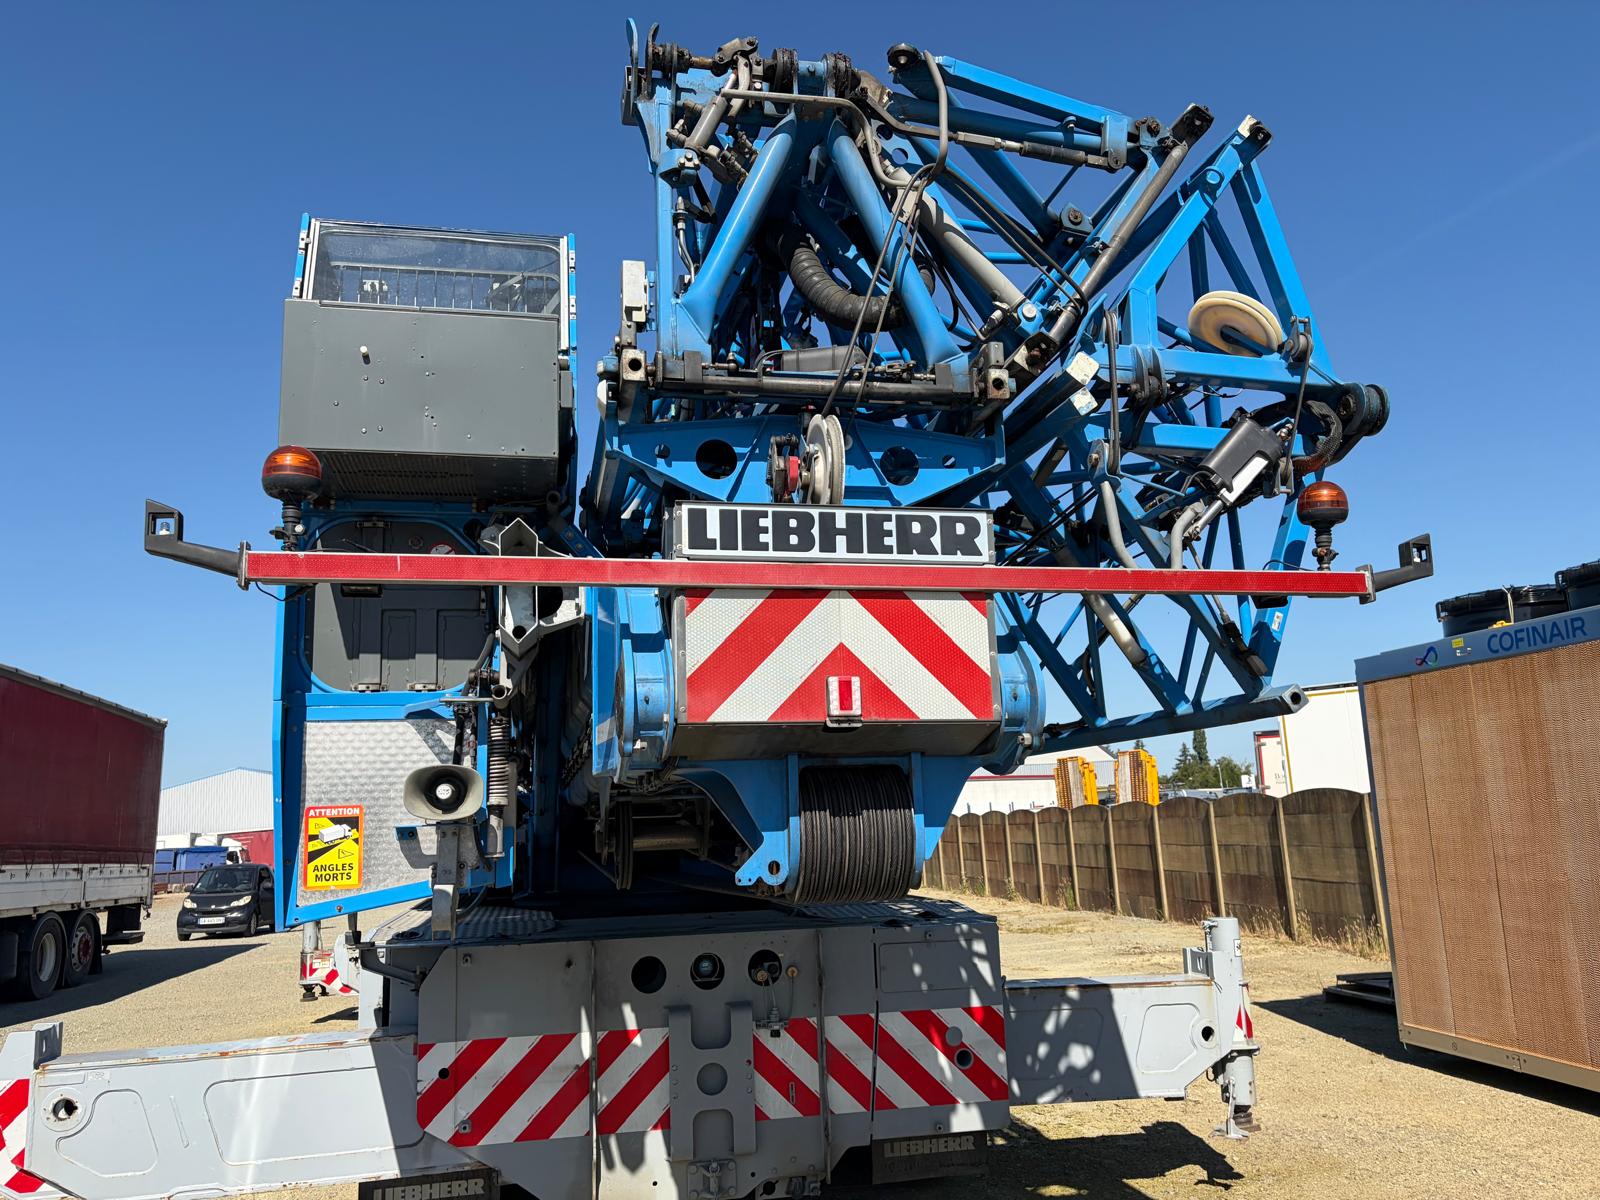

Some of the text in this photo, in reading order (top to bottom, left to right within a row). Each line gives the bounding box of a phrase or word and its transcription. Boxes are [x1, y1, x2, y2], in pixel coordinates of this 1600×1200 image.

[687, 507, 983, 557] LIEBHERR
[1486, 616, 1588, 654] COFINAIR
[308, 807, 360, 817] ATTENTION
[312, 862, 354, 873] ANGLES
[314, 872, 352, 882] MORTS
[883, 1135, 976, 1158] LIEBHERR
